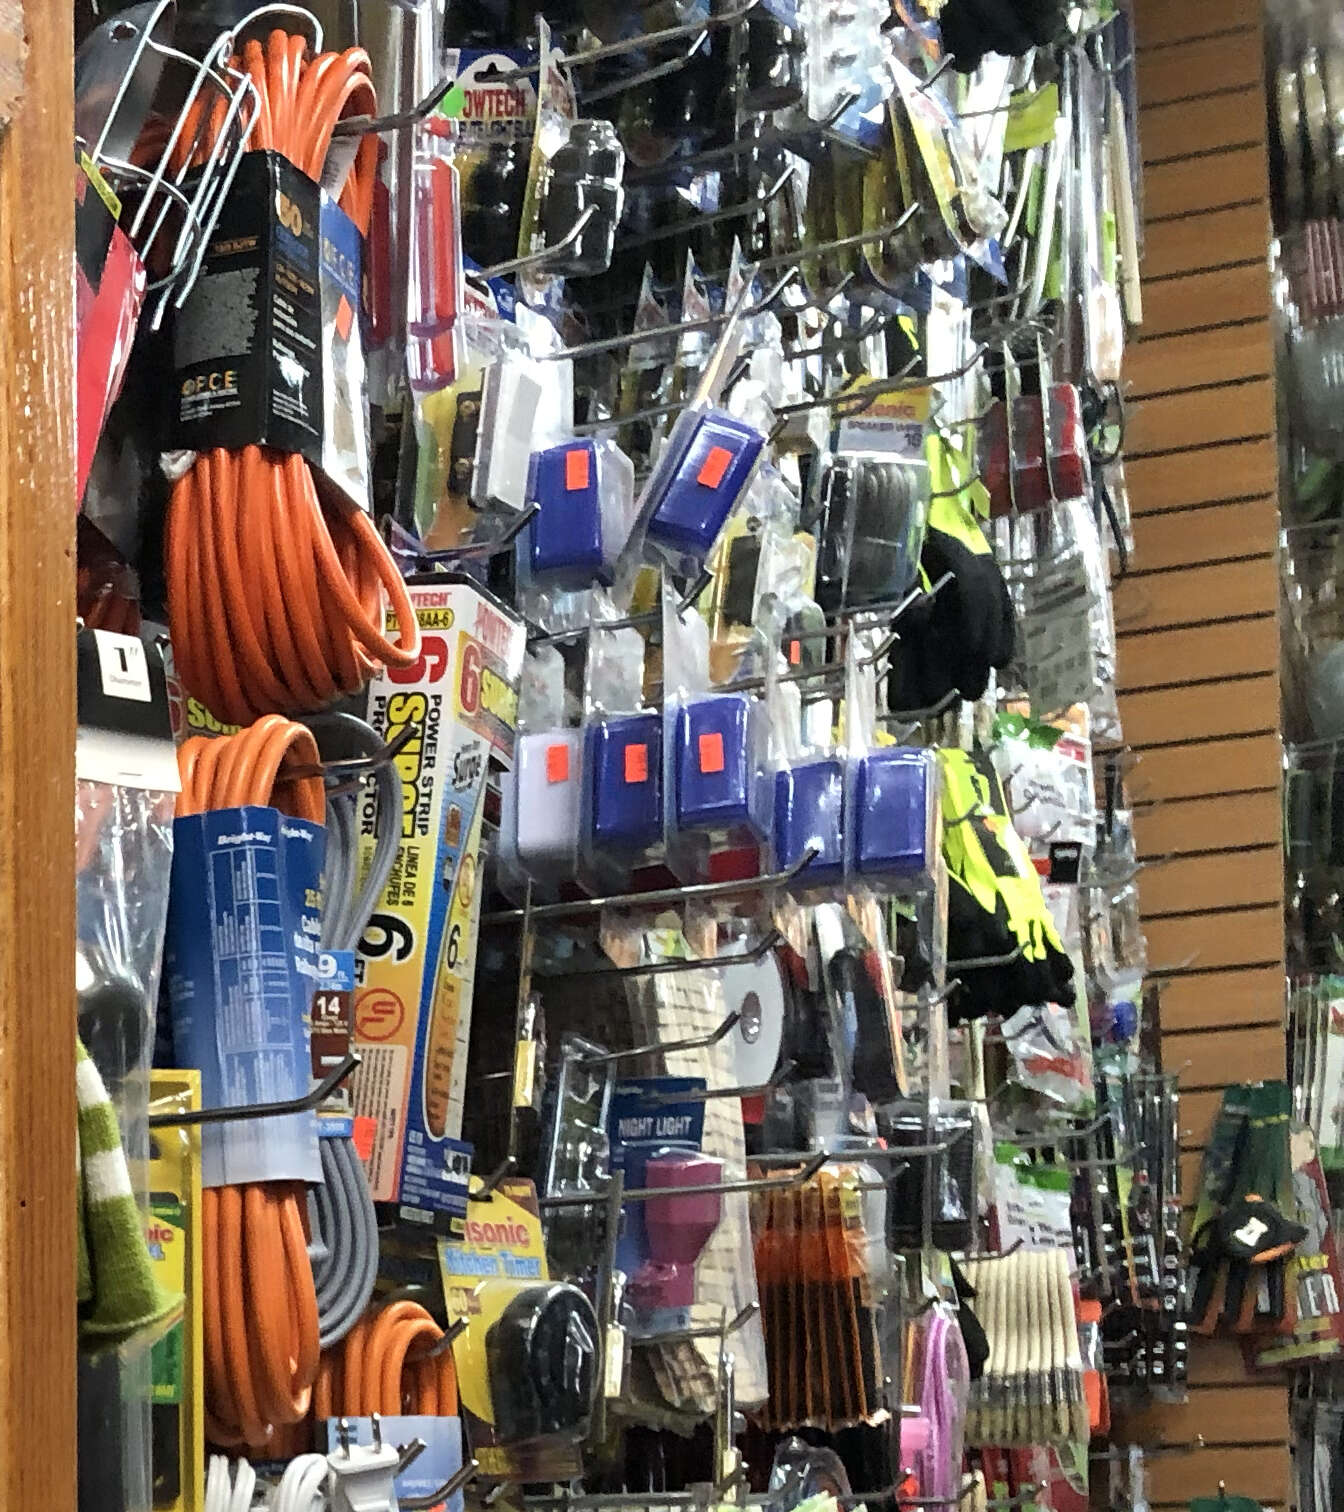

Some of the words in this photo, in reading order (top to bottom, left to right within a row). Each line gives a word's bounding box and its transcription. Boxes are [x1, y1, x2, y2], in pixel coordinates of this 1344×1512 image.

[425, 695, 442, 772] POWER
[419, 775, 436, 838] STRIP
[408, 844, 420, 882] LINEA
[316, 994, 341, 1015] 14
[618, 1115, 649, 1138] NIGHT
[652, 1115, 692, 1137] LIGHT
